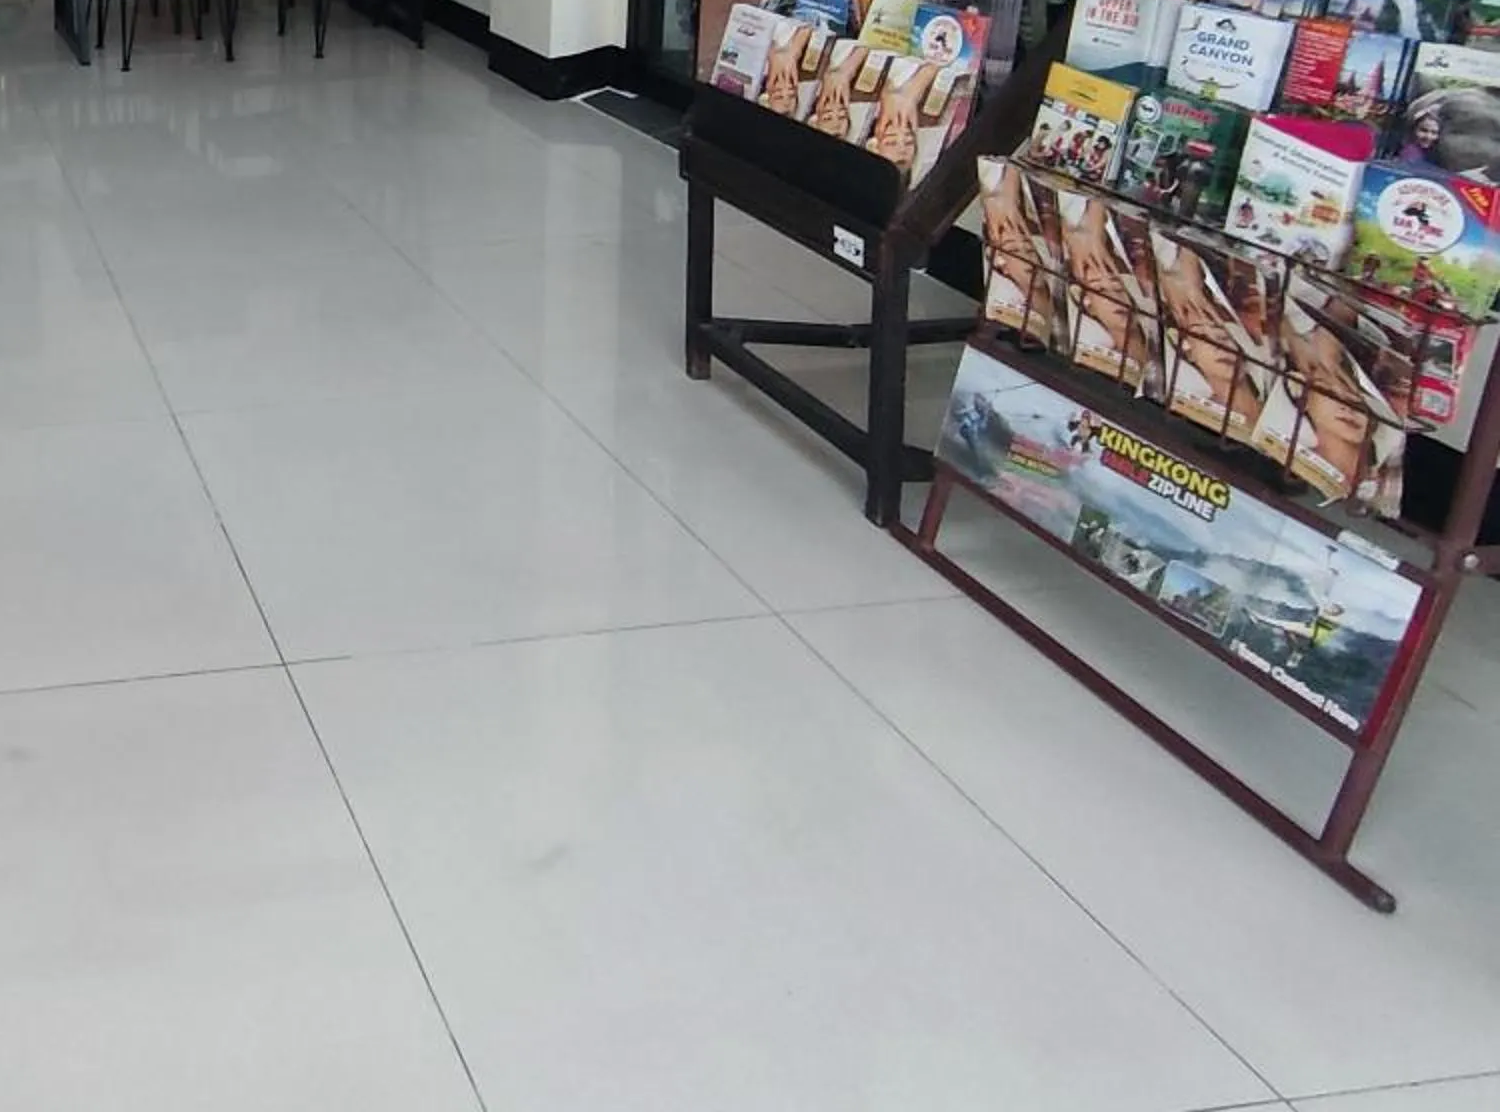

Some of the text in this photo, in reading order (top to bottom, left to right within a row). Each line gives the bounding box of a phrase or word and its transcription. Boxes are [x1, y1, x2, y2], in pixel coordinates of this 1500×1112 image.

[1188, 43, 1255, 67] CANYON
[1196, 31, 1251, 52] GRAND
[1099, 425, 1229, 509] KINGKONG
[1148, 472, 1216, 521] ZIPLINE
